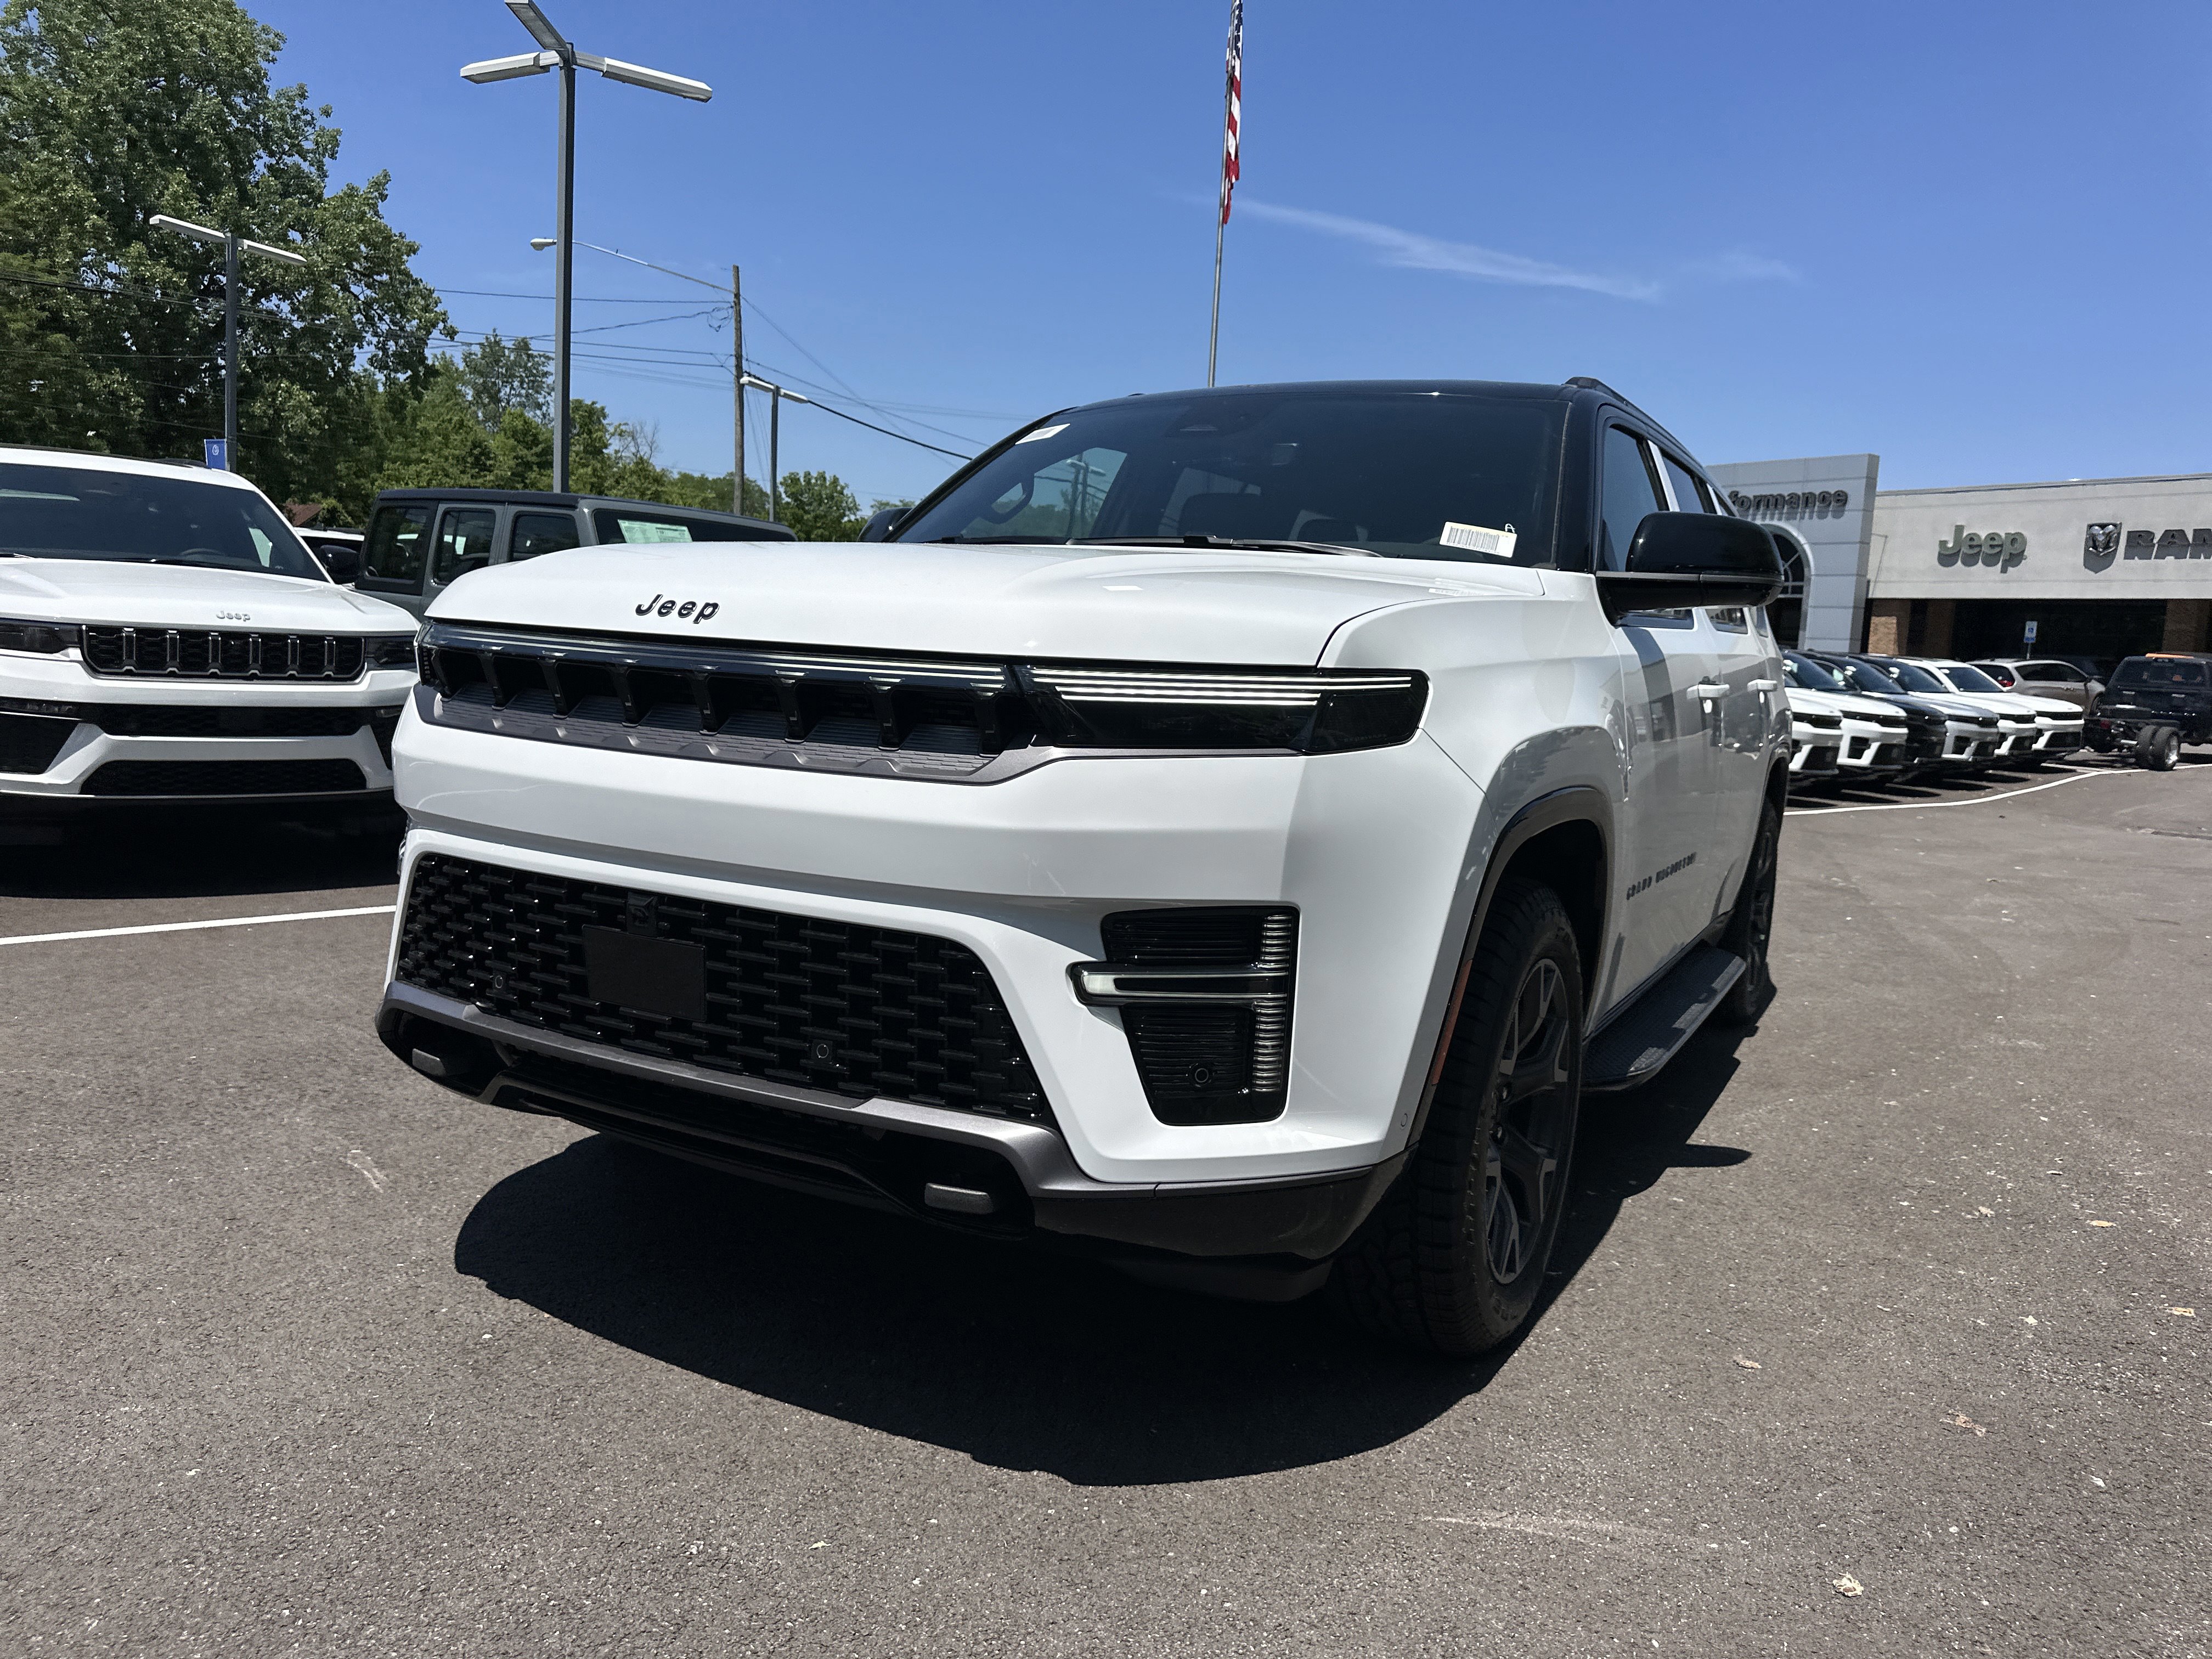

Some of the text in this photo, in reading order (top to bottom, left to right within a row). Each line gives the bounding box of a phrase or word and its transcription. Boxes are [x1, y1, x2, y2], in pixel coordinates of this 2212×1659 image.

[1939, 524, 2028, 560] Jeep
[216, 611, 250, 622] Jeep
[635, 594, 720, 624] Jeep
